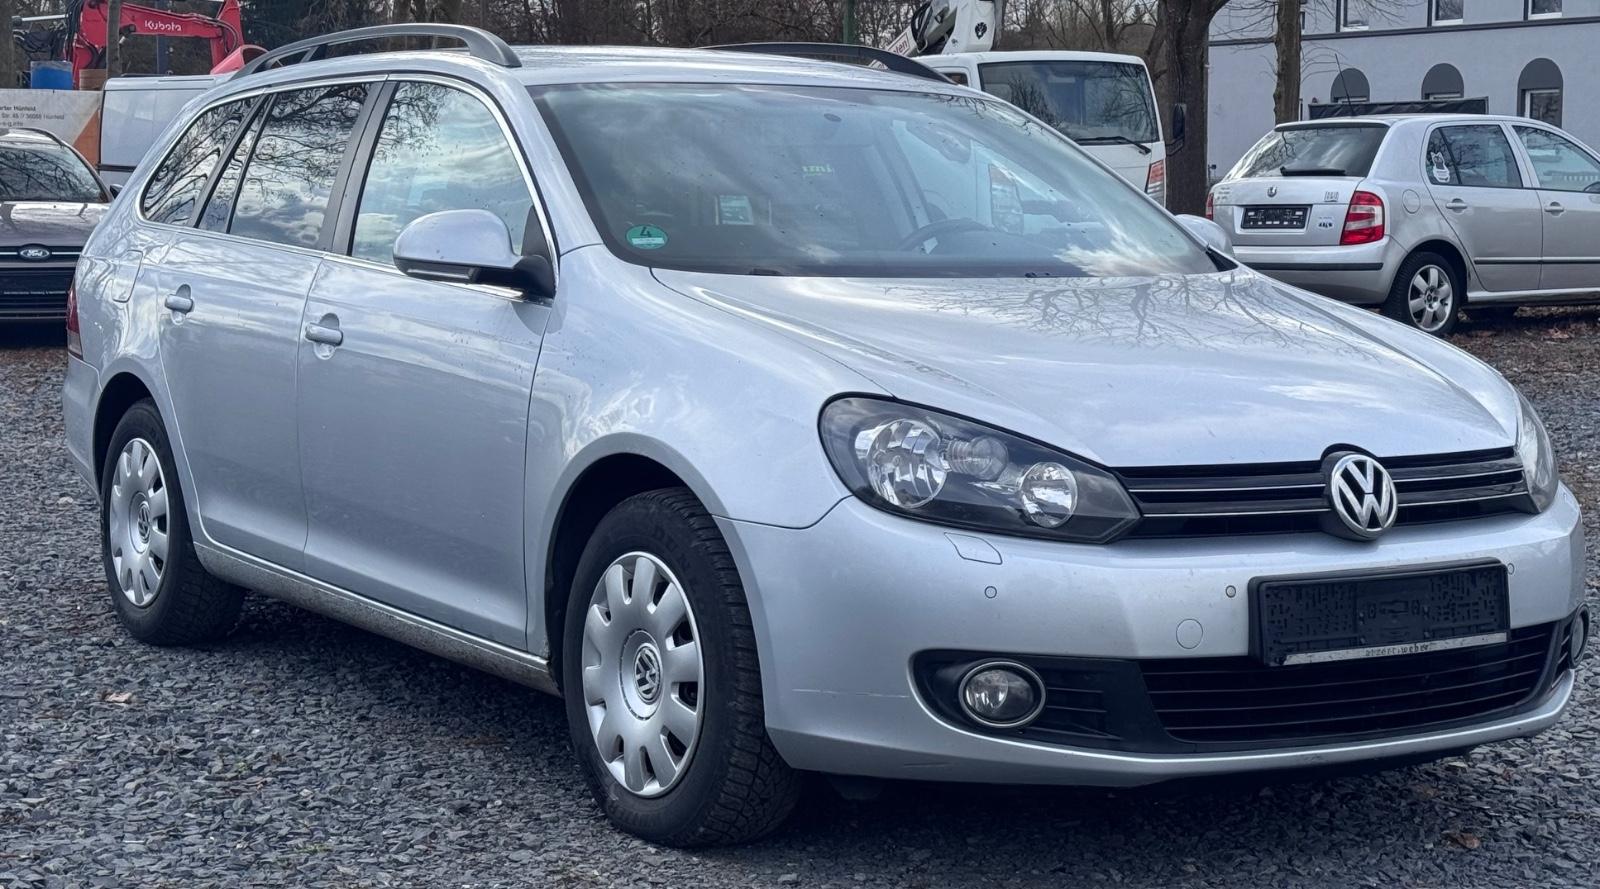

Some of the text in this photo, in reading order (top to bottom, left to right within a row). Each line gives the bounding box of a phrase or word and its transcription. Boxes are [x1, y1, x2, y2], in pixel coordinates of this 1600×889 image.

[144, 20, 183, 32] Kubota
[639, 226, 652, 238] 4
[25, 249, 45, 257] Ford
